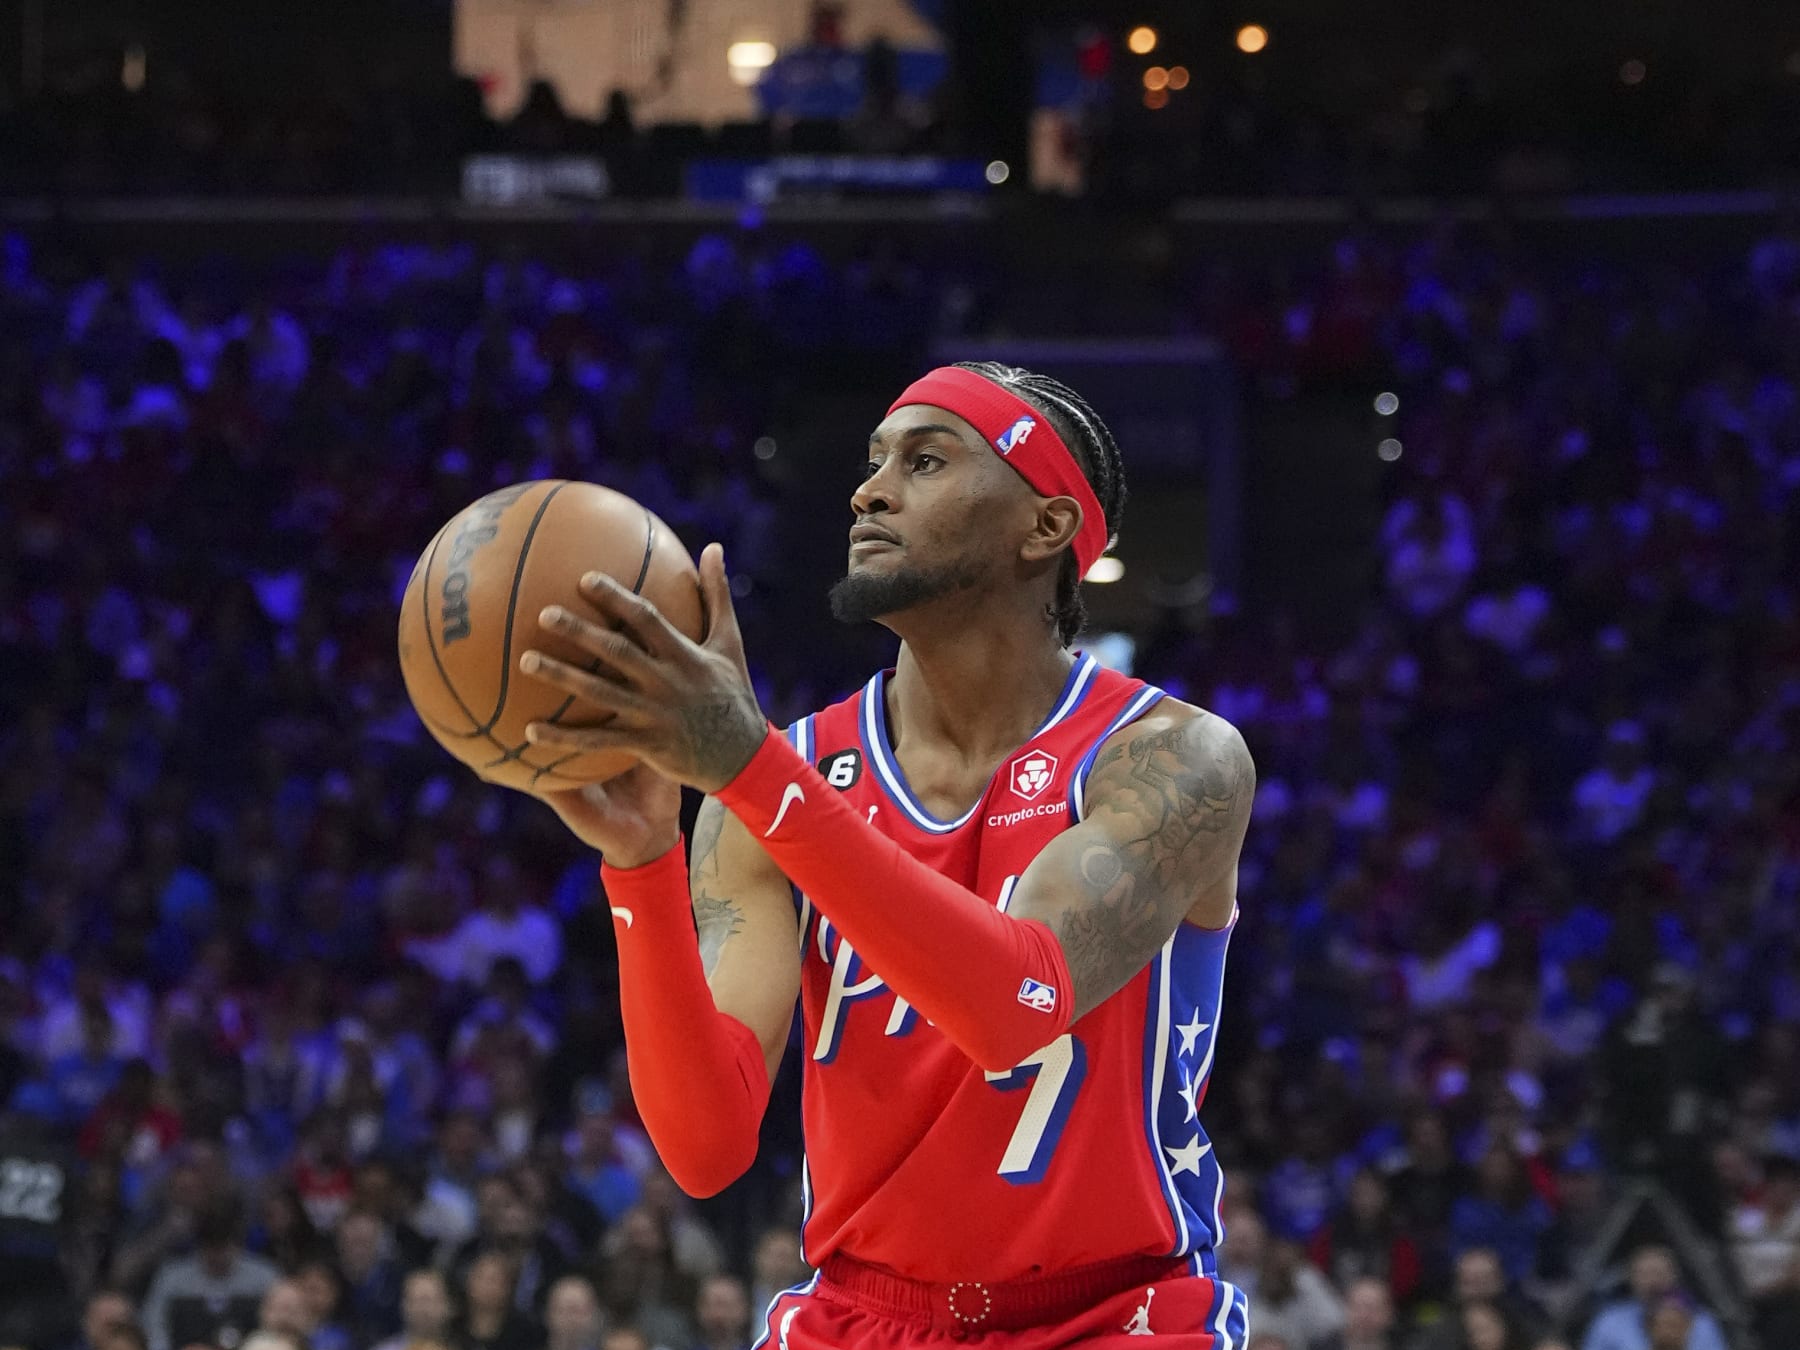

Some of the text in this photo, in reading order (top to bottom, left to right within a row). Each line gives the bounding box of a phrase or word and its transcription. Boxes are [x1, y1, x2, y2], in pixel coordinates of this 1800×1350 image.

[827, 754, 856, 787] 6
[988, 801, 1067, 826] crypto.com
[985, 1034, 1083, 1182] 7
